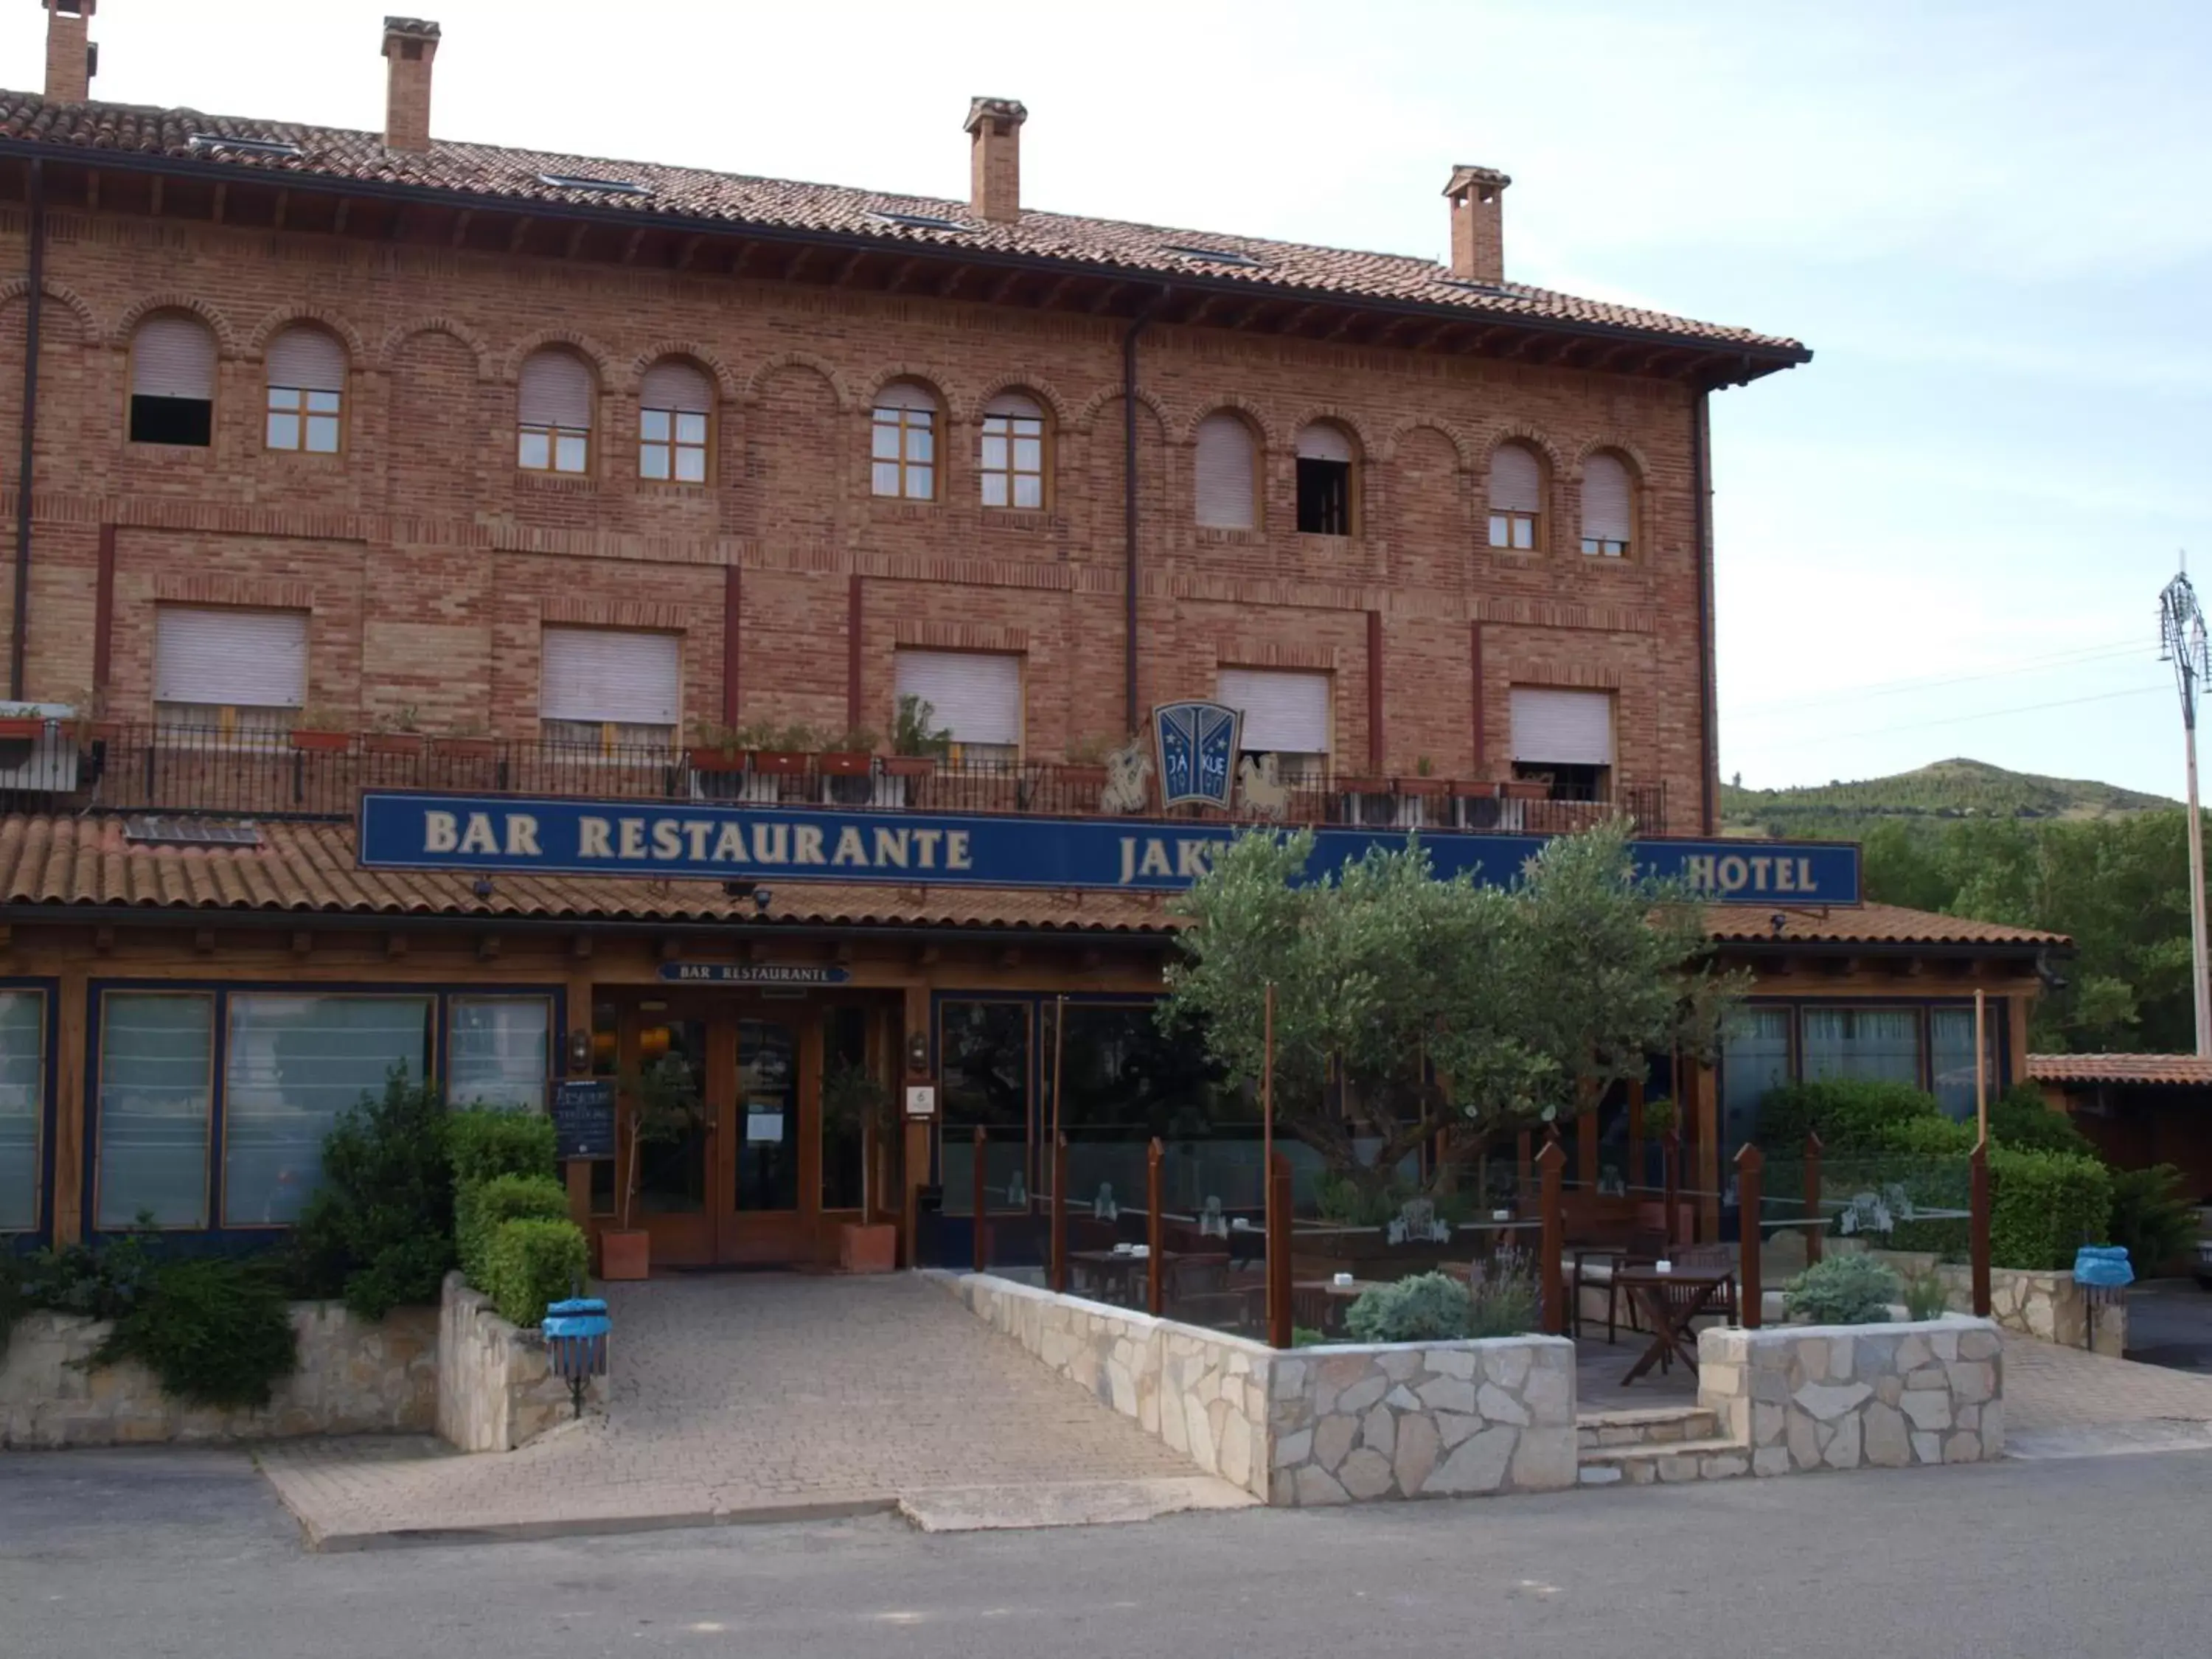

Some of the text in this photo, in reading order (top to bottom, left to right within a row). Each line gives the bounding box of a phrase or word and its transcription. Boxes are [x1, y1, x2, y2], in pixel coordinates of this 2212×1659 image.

[423, 811, 543, 855] BAR
[578, 816, 972, 869] RESTAURANTE
[1688, 855, 1818, 891] HOTEL
[679, 965, 829, 981] BAR RESTAURANTE
